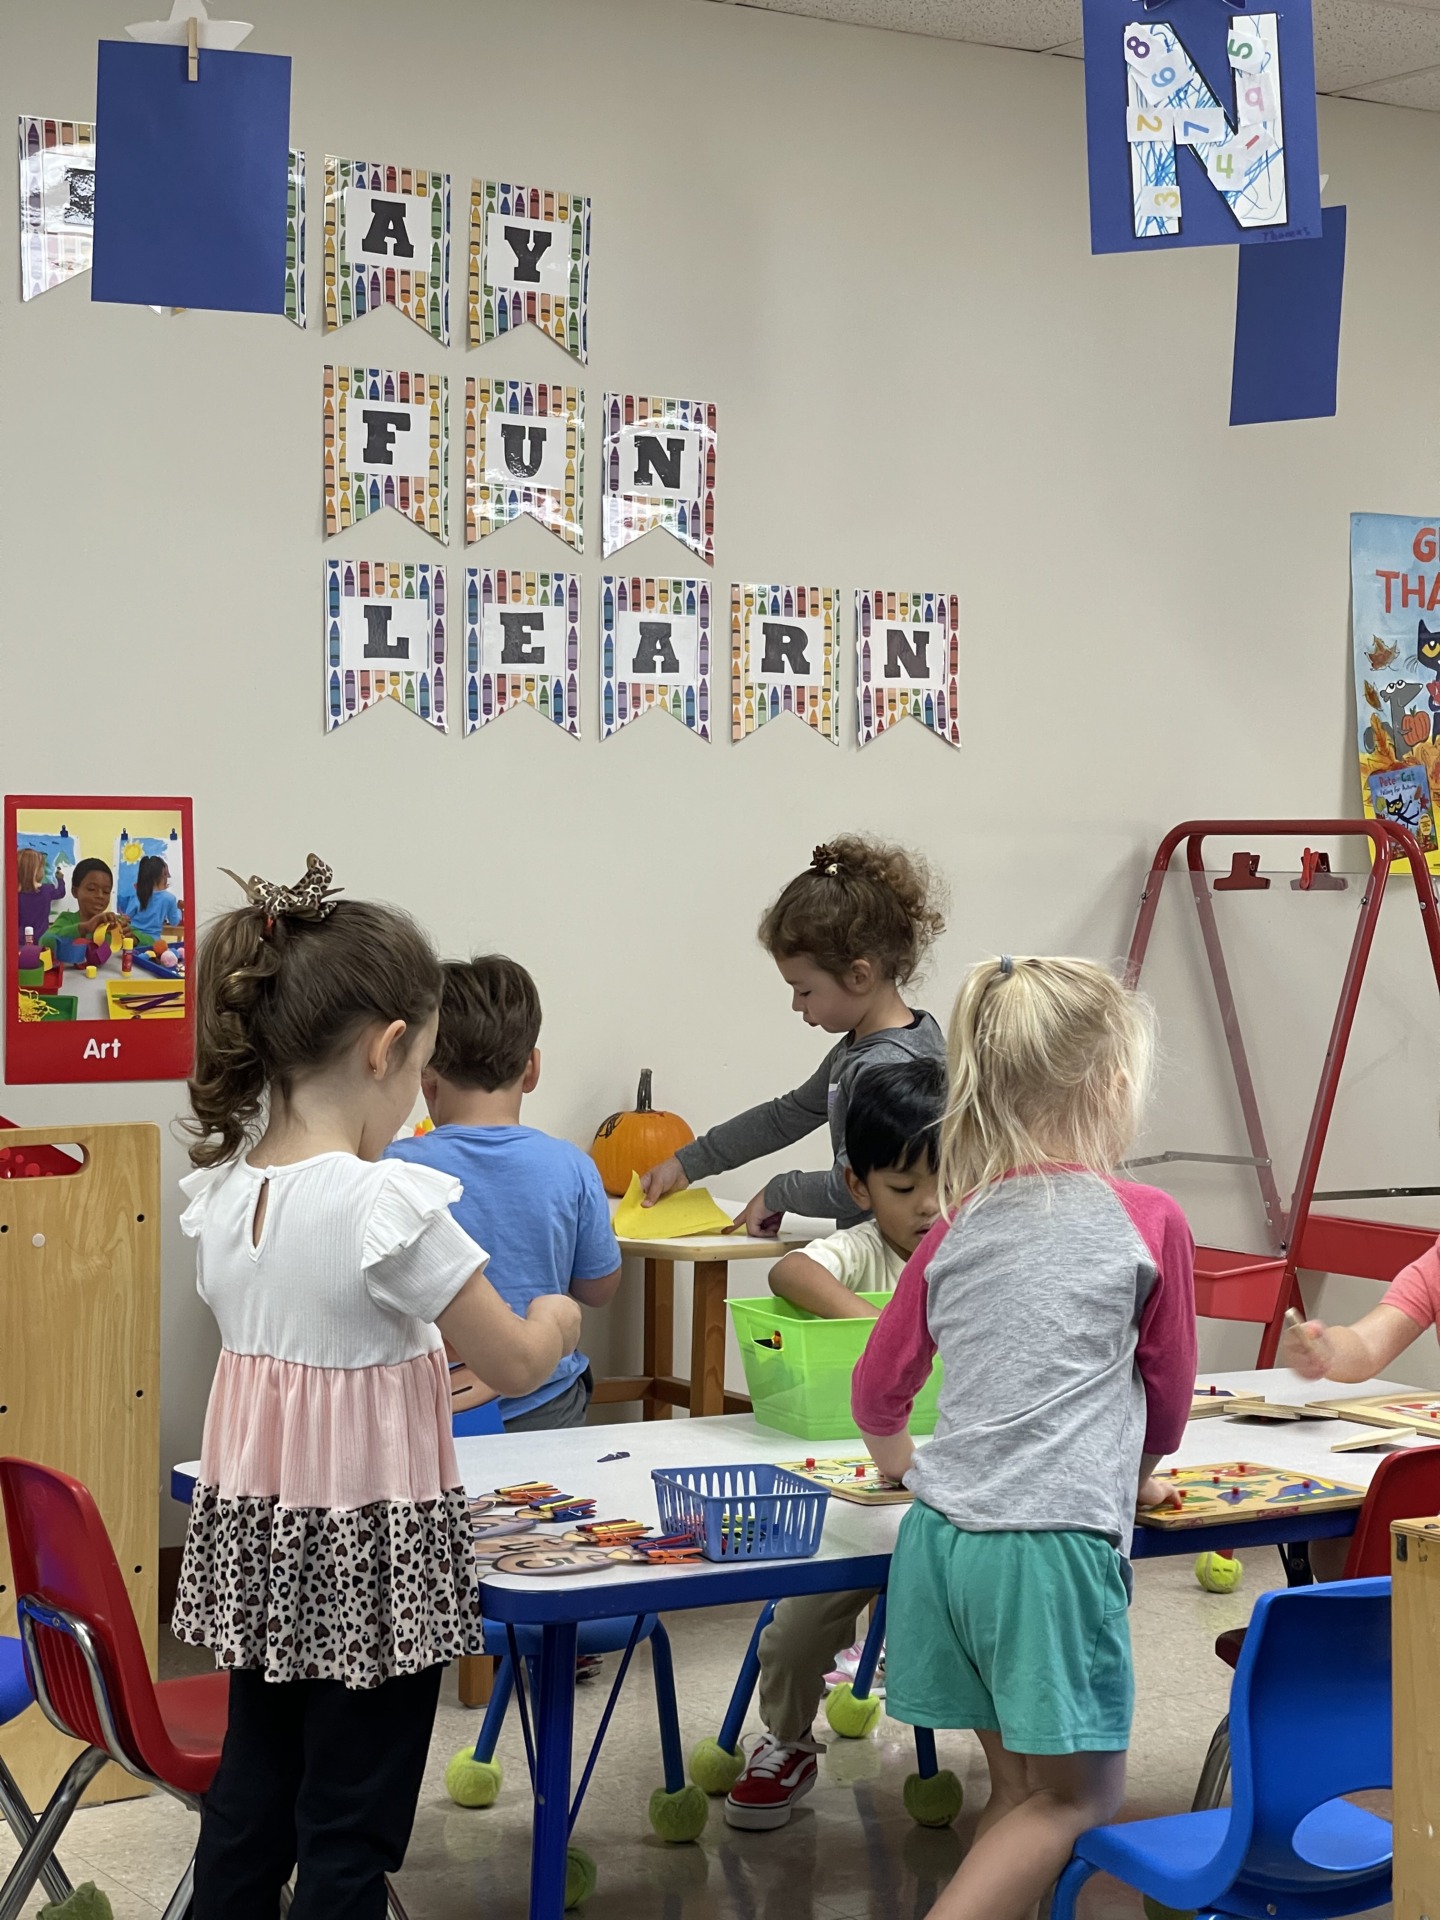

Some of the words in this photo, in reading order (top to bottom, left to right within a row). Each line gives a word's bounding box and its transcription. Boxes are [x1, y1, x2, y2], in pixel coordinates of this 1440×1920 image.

[1126, 36, 1150, 59] 8
[1228, 38, 1253, 60] 5
[1136, 113, 1163, 132] 2
[1183, 120, 1210, 137] 7
[1215, 153, 1235, 179] 4
[1154, 190, 1179, 208] 3
[362, 409, 686, 490] FUN
[1412, 527, 1440, 563] G
[363, 605, 930, 679] LEARN
[83, 1038, 122, 1060] Art
